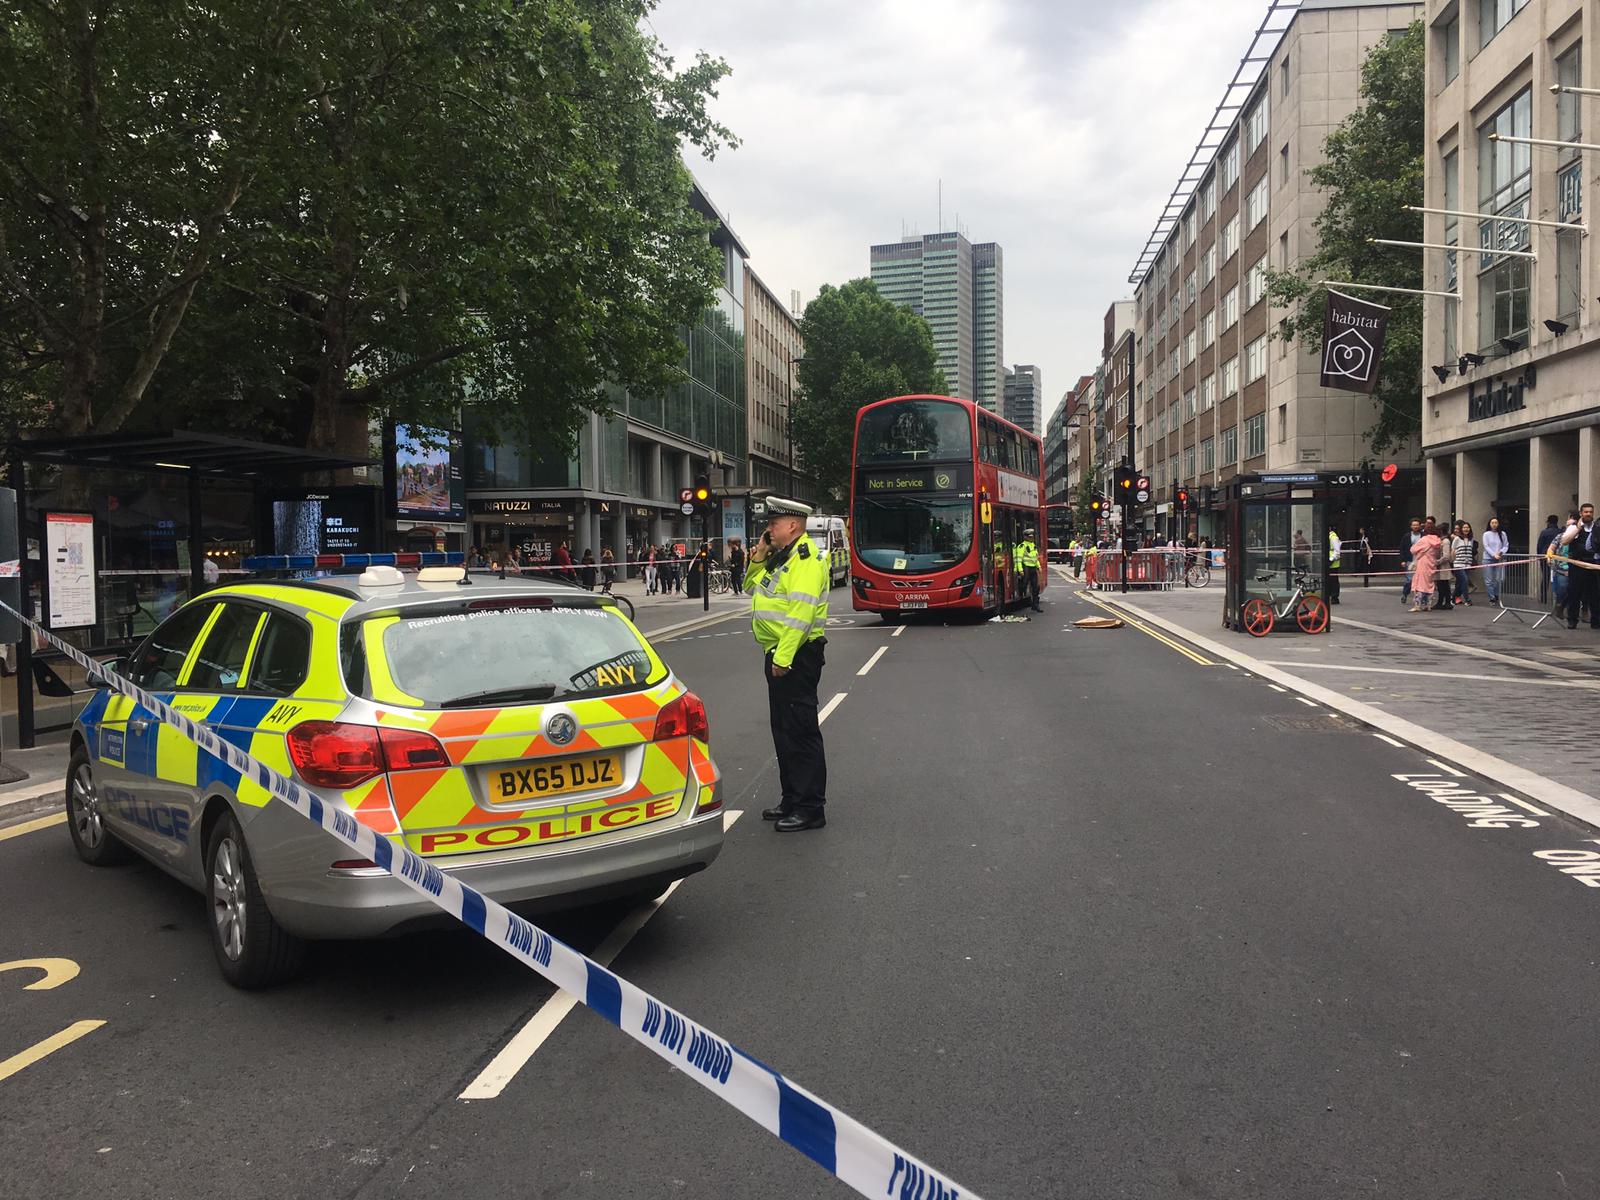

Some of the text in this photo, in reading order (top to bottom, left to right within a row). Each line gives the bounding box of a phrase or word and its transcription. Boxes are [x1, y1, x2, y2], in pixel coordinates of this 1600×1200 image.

[1331, 308, 1380, 329] habitat
[869, 478, 923, 488] Not in Service
[1331, 475, 1371, 484] OST
[484, 501, 531, 511] NATUZZI
[601, 502, 610, 512] N
[523, 542, 551, 552] SALE
[407, 613, 466, 630] Recruiting
[468, 607, 500, 621] police
[503, 606, 542, 616] officers
[551, 607, 581, 616] APPLY
[585, 608, 608, 619] NOW
[594, 665, 637, 687] AVY
[266, 704, 303, 725] AVY
[500, 759, 614, 797] BX65 DJZ
[1390, 774, 1541, 828] LOADING
[104, 786, 190, 844] POLICE
[420, 796, 676, 853] POLICE
[505, 912, 552, 968] POLICE LINE
[641, 997, 733, 1085] DO NOT CROSS
[887, 1152, 959, 1200] POLI
